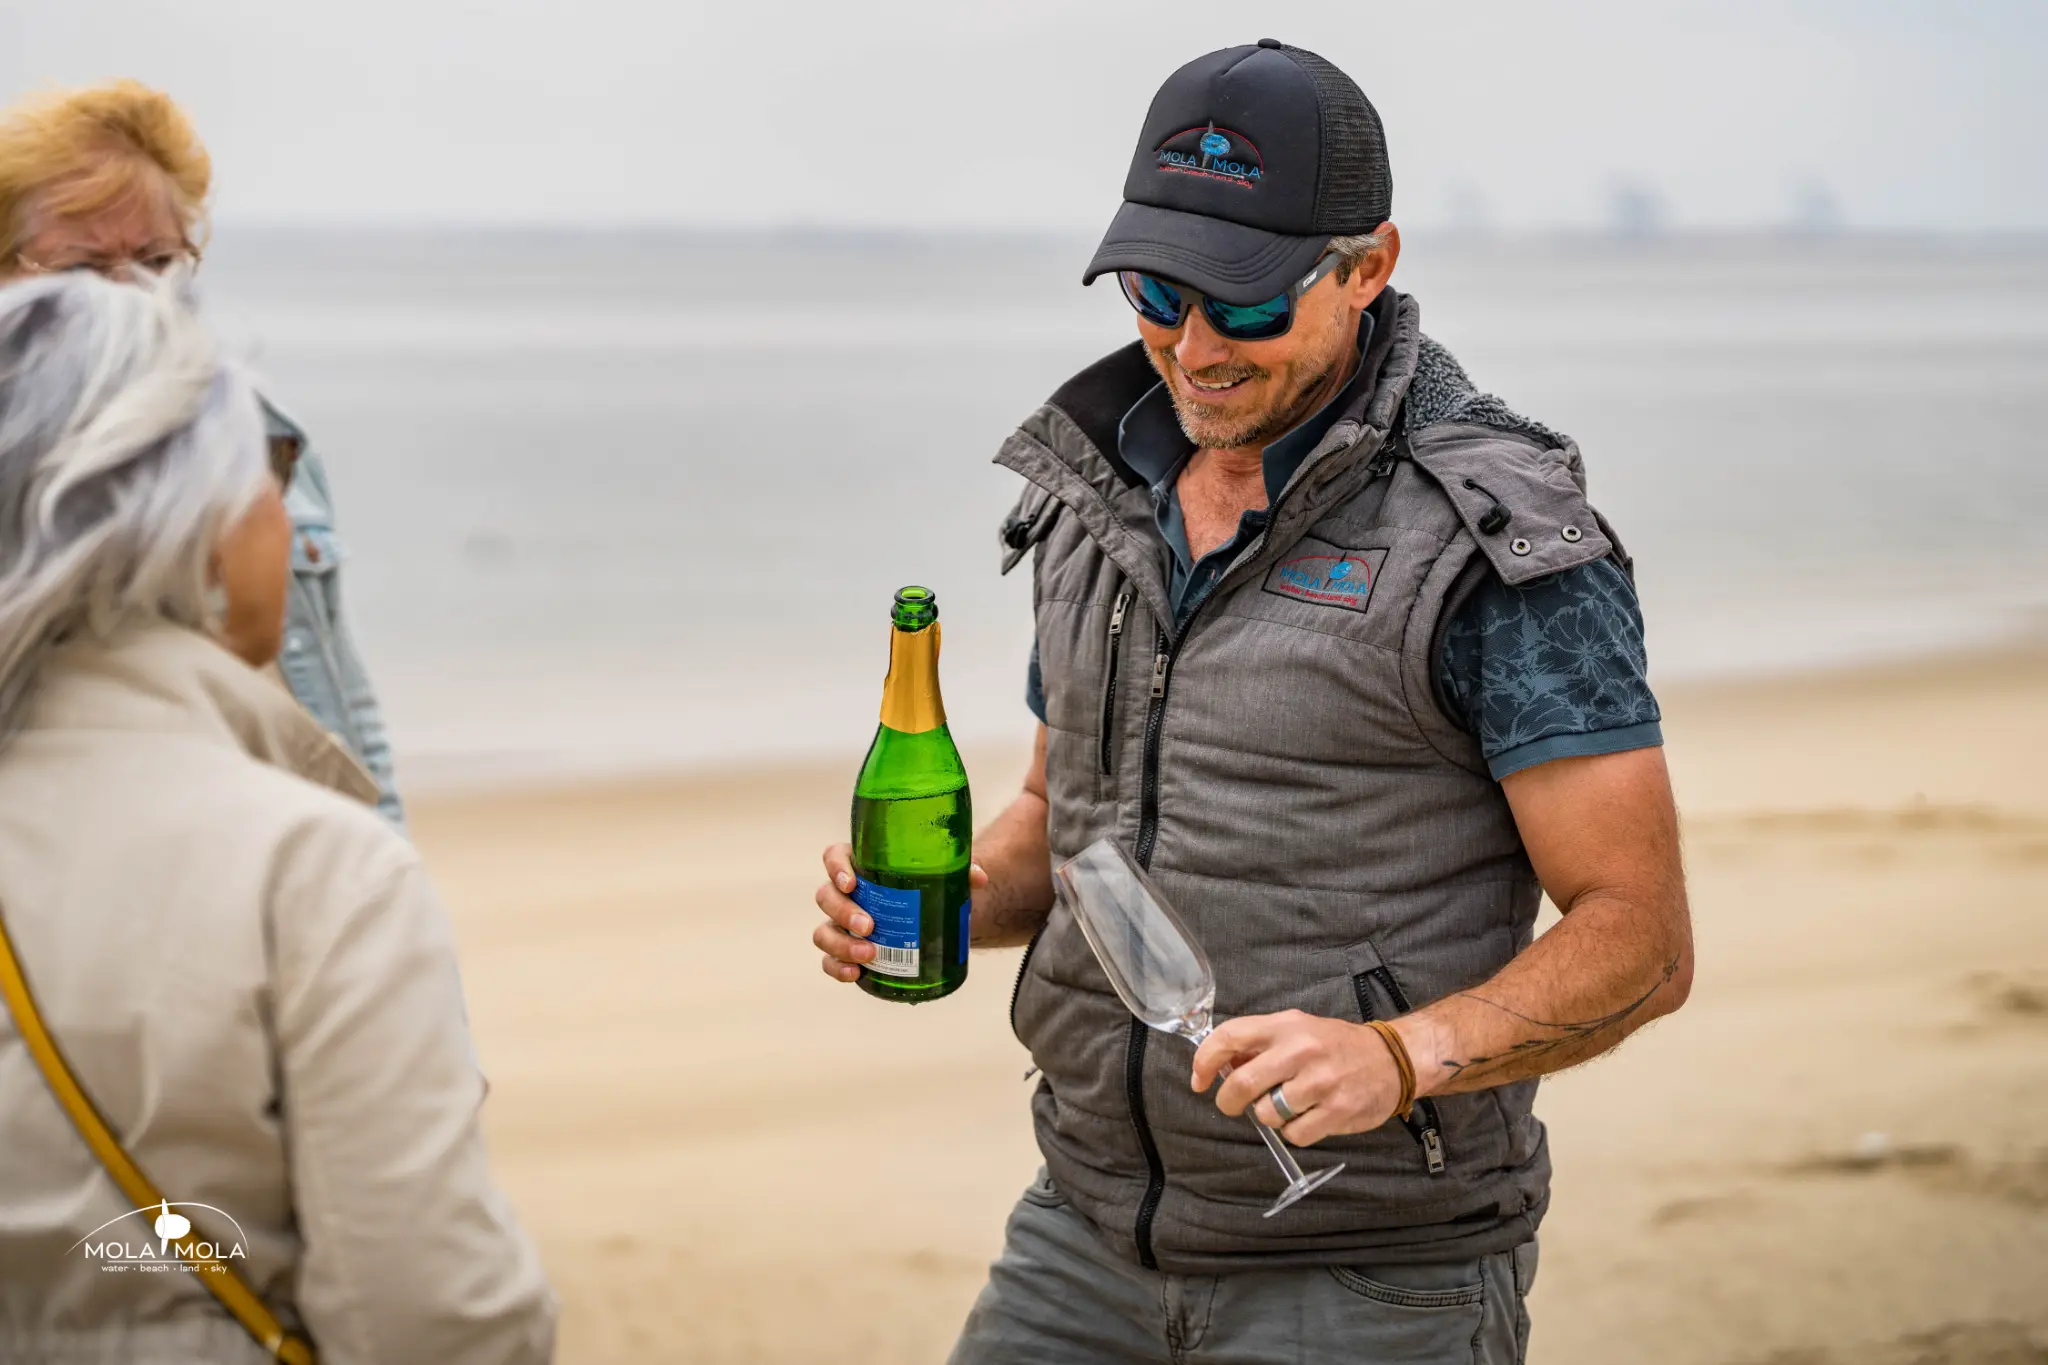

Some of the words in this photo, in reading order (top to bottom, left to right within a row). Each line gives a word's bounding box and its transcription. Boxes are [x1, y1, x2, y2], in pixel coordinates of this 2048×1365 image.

[1159, 150, 1197, 166] MOLA
[1212, 157, 1261, 179] MOLA
[1280, 567, 1321, 589] MOLA
[1331, 580, 1367, 595] MOLA
